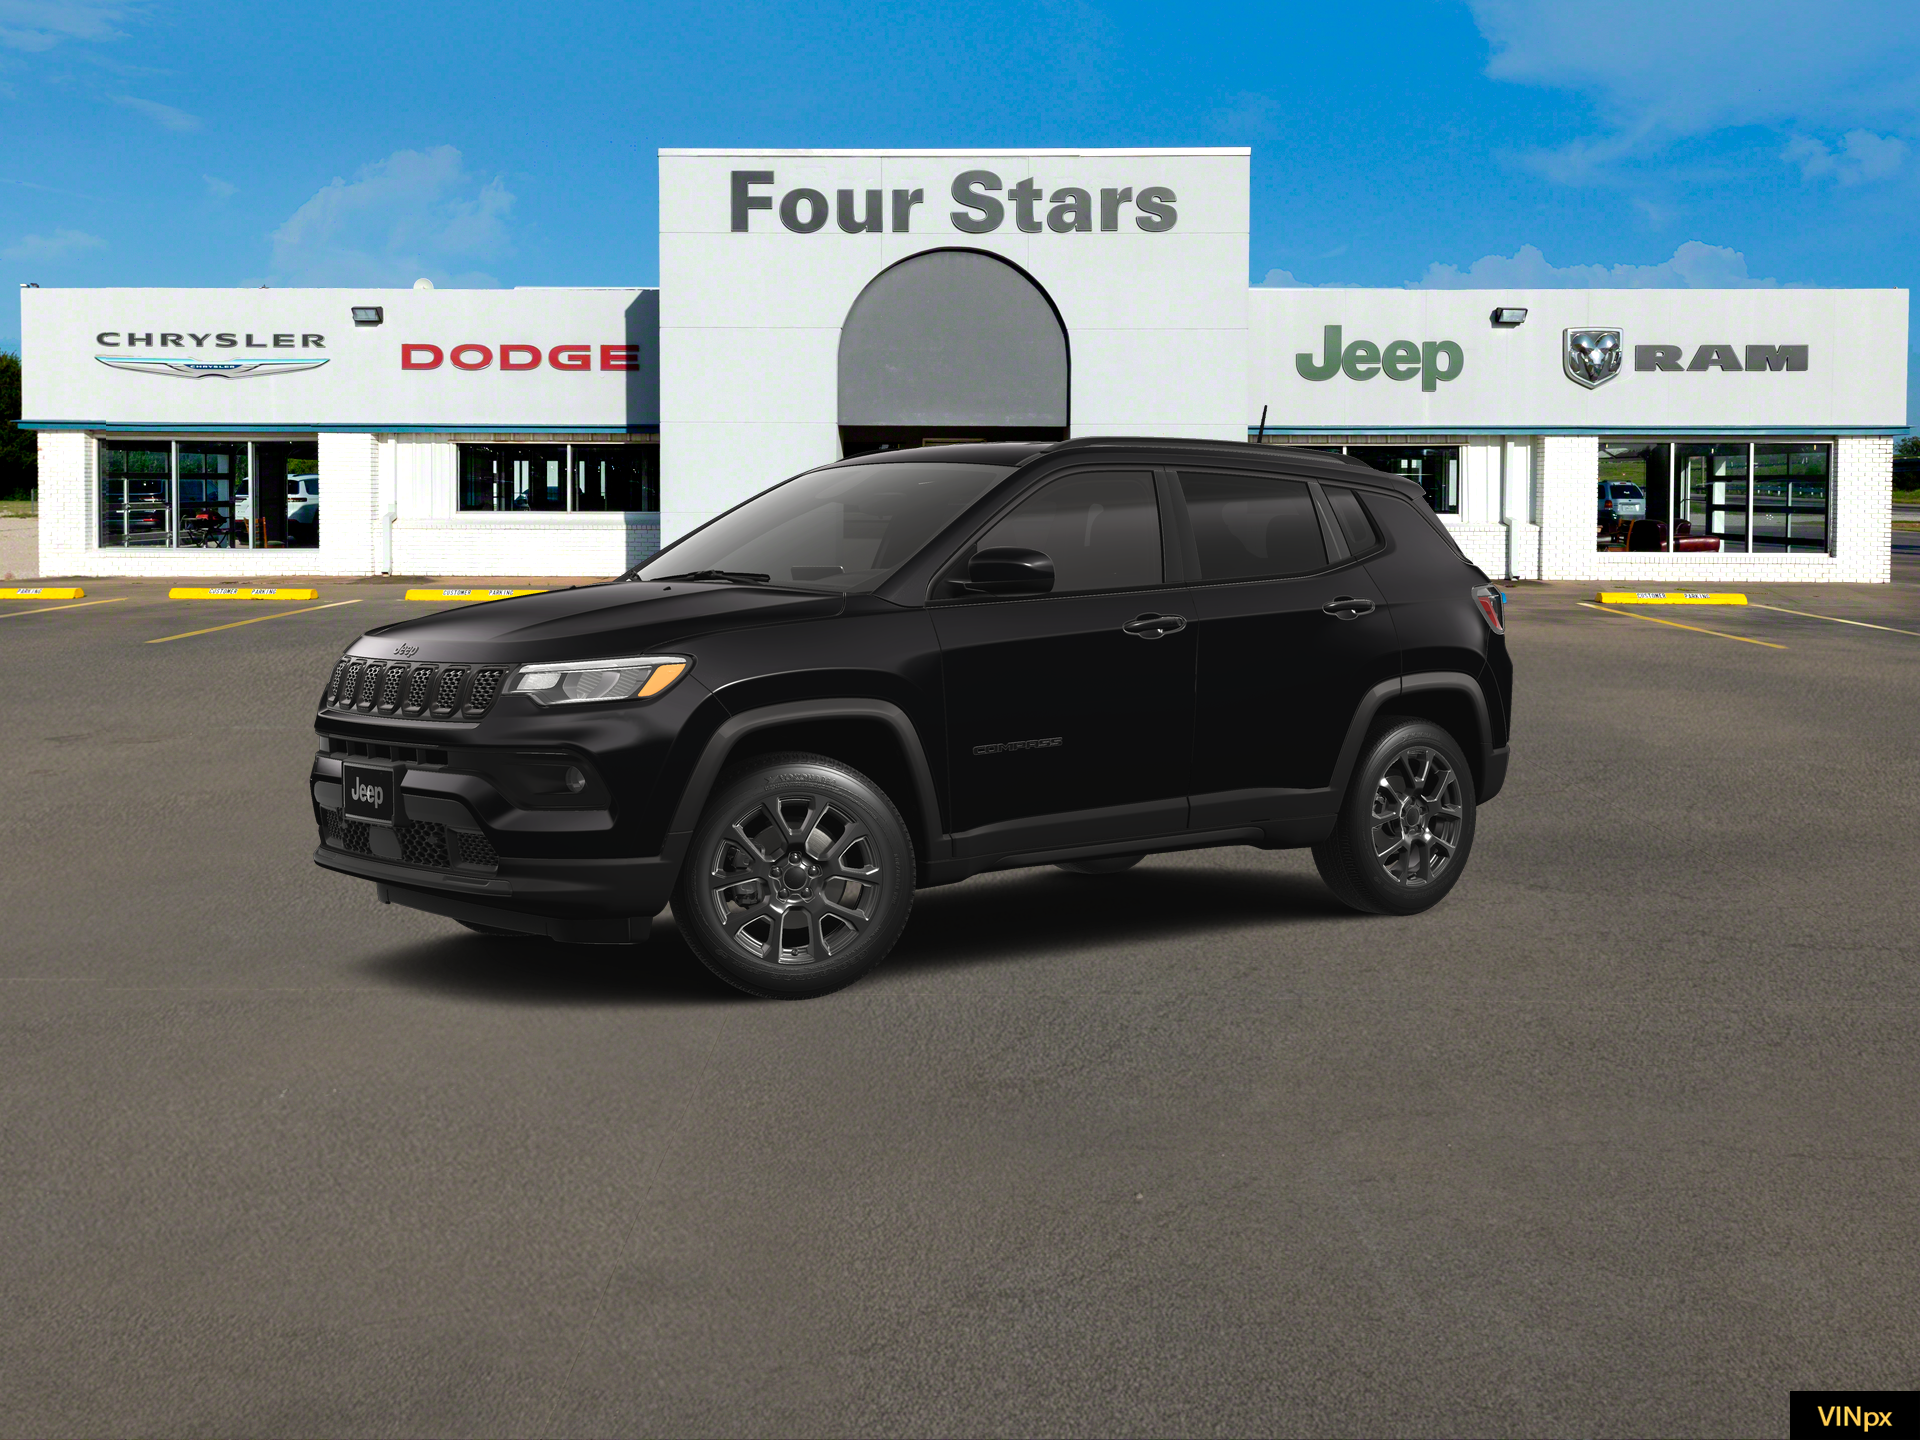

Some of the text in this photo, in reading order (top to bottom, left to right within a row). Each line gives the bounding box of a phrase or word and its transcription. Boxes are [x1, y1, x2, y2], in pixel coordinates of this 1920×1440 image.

[730, 168, 1178, 234] Four Stars
[96, 331, 327, 350] CHRYSLER
[401, 343, 640, 372] DODGE
[1296, 324, 1464, 392] Jeep
[1633, 344, 1809, 372] RAM
[393, 643, 420, 658] Jeep
[972, 736, 1063, 755] COMPASS
[351, 776, 384, 809] Jeep
